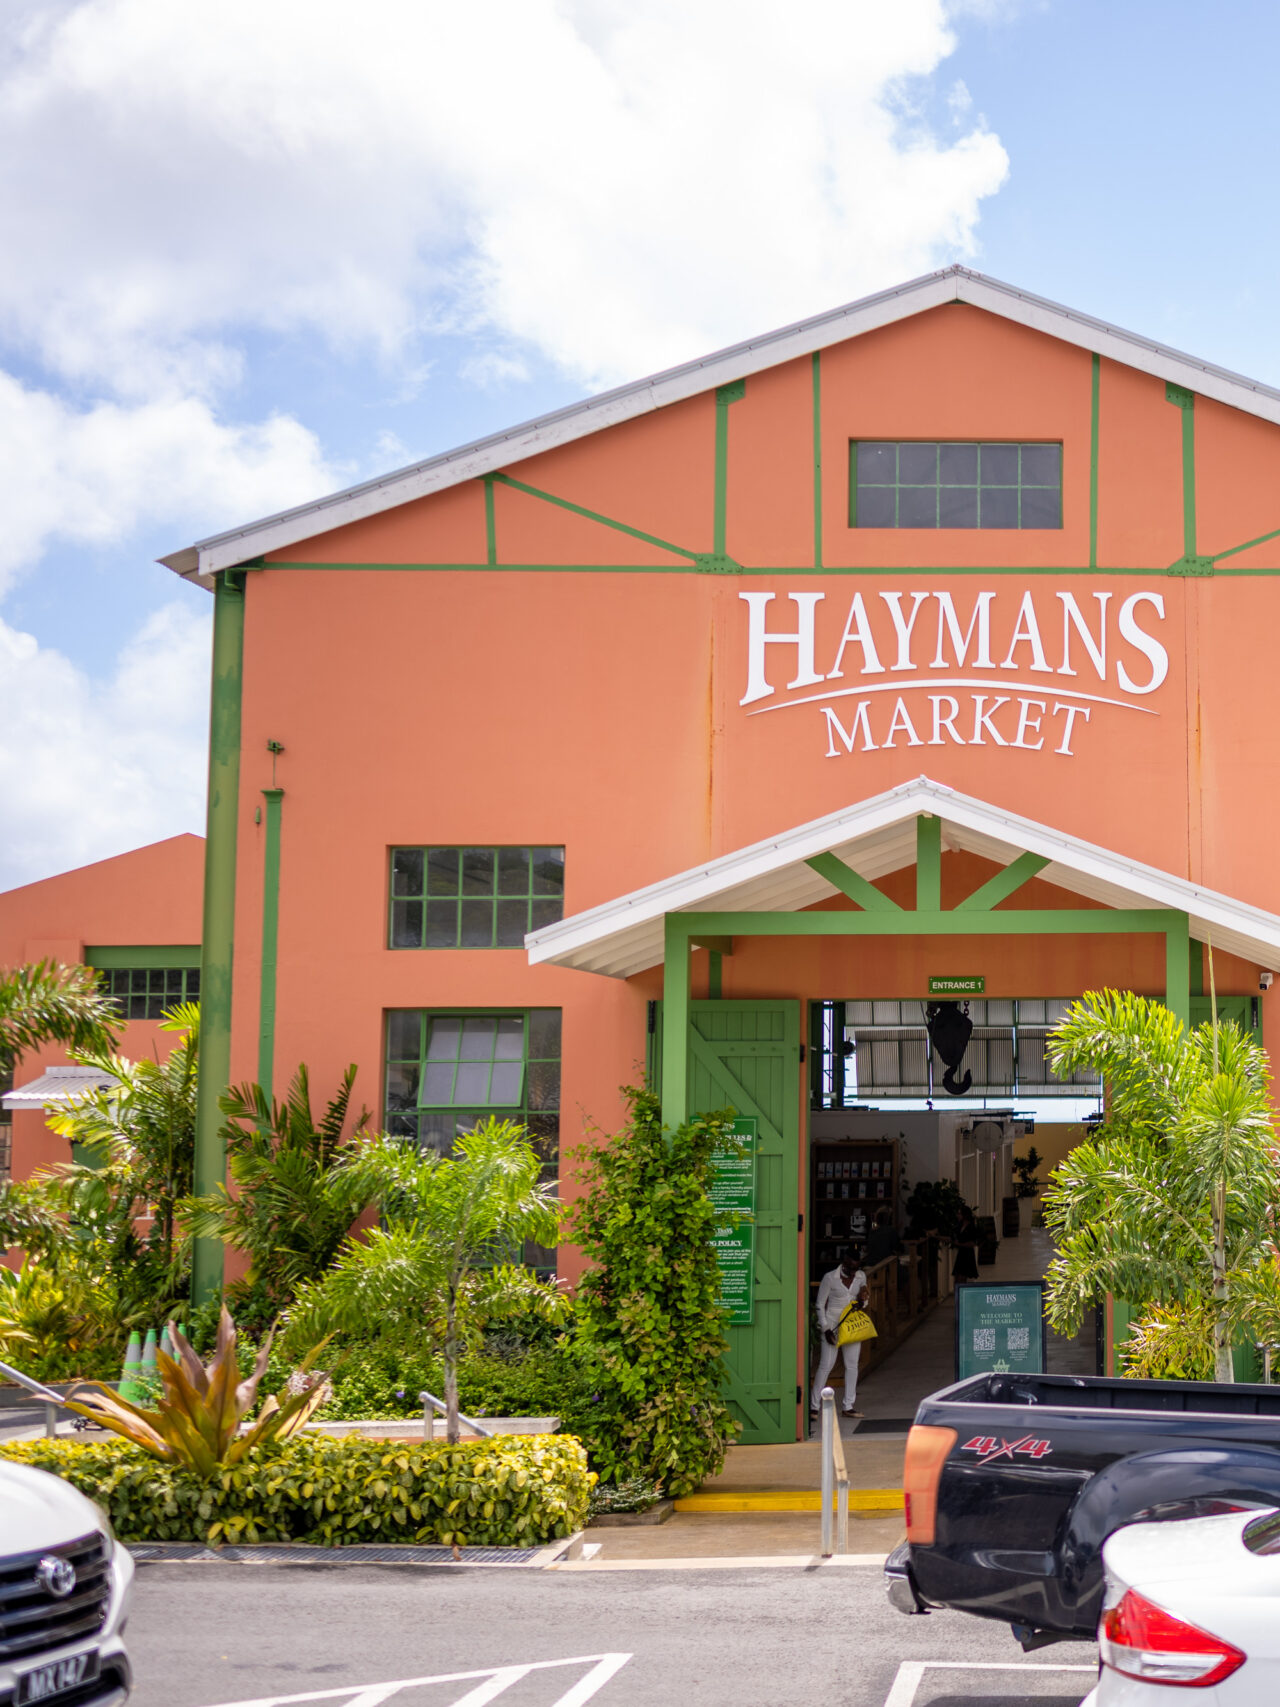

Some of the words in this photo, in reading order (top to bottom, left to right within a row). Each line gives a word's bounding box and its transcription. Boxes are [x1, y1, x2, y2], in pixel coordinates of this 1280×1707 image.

[738, 590, 1169, 706] HAYMANS
[820, 694, 1091, 758] MARKET
[932, 981, 976, 989] ENTRANCE
[977, 981, 982, 989] 1
[986, 1294, 1017, 1304] HAYMANS
[27, 1654, 89, 1700] MX147
